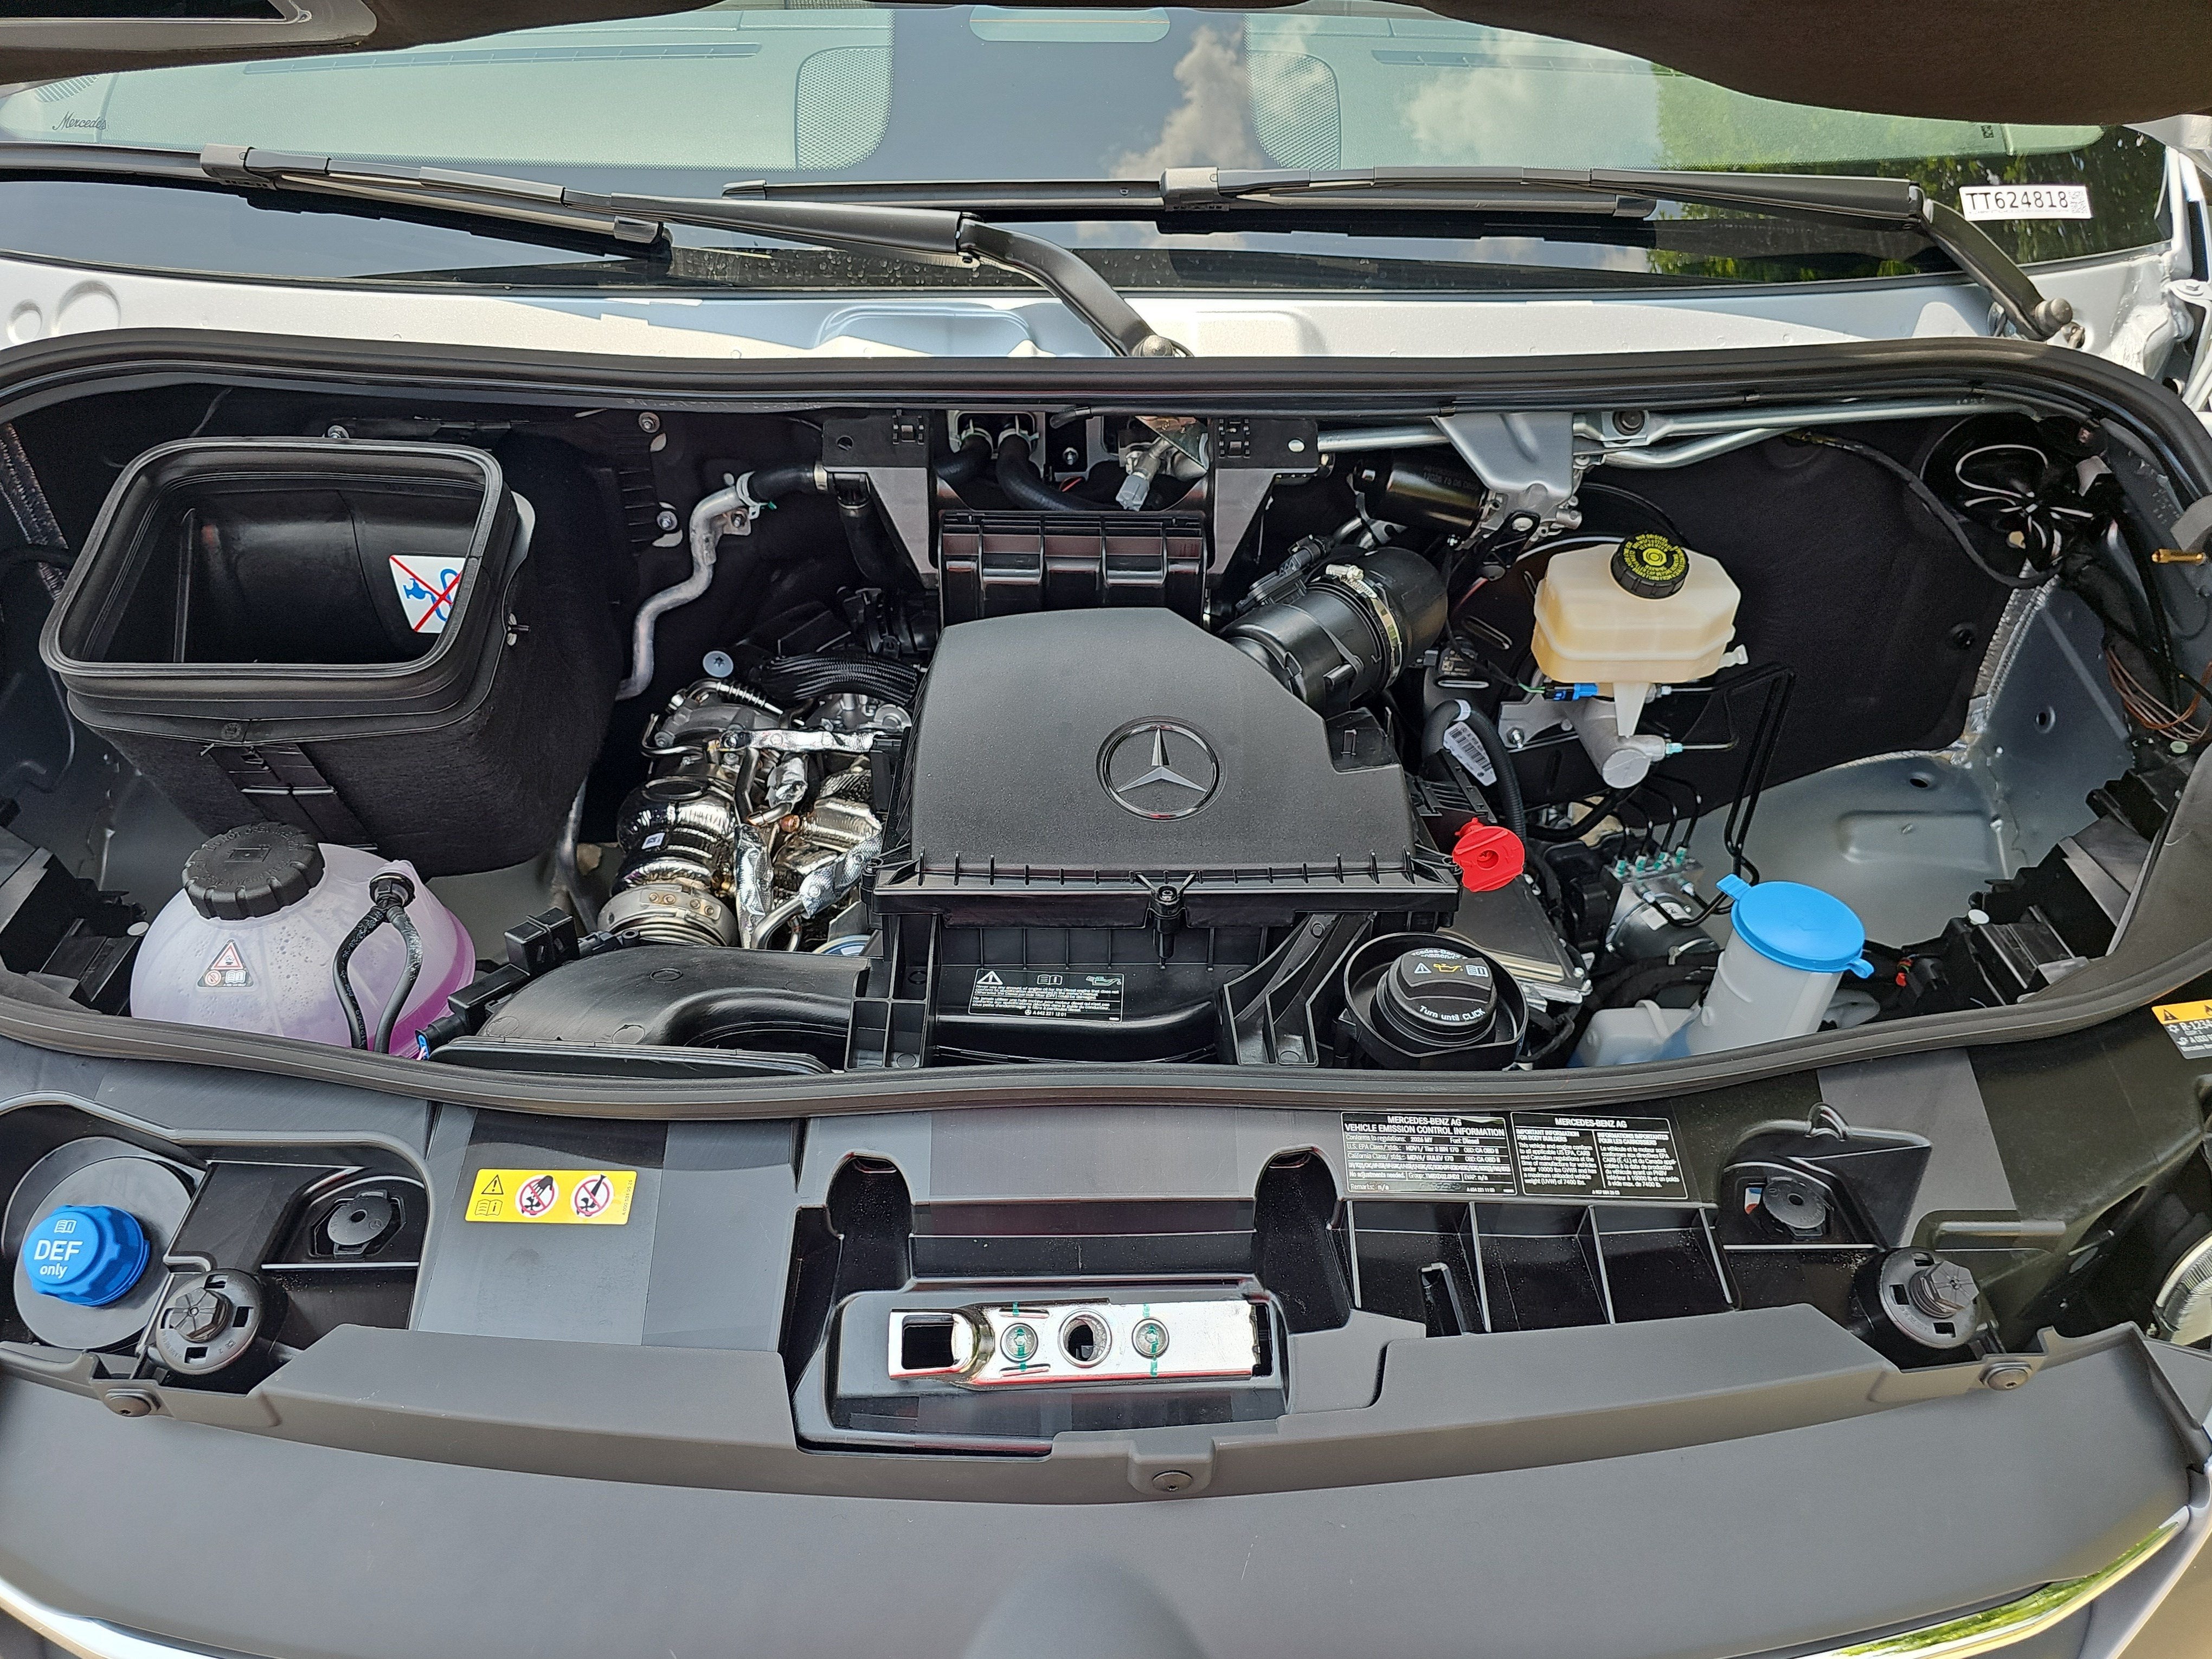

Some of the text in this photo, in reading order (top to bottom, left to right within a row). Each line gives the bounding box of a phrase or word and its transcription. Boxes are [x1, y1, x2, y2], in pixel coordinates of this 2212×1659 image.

[52, 111, 106, 131] Mercedes
[1966, 191, 2068, 209] TT624818
[1419, 1005, 1438, 1018] Turn
[1462, 1008, 1486, 1021] CLICK
[1387, 1116, 1462, 1126] MERCEDES-BENZ AG
[1554, 1118, 1628, 1128] MERCEDES-BENZ AG
[1344, 1123, 1505, 1136] VEHICLE EMISSION CONTROL INFORMATION
[34, 1239, 83, 1261] DEF
[40, 1263, 68, 1279] only
